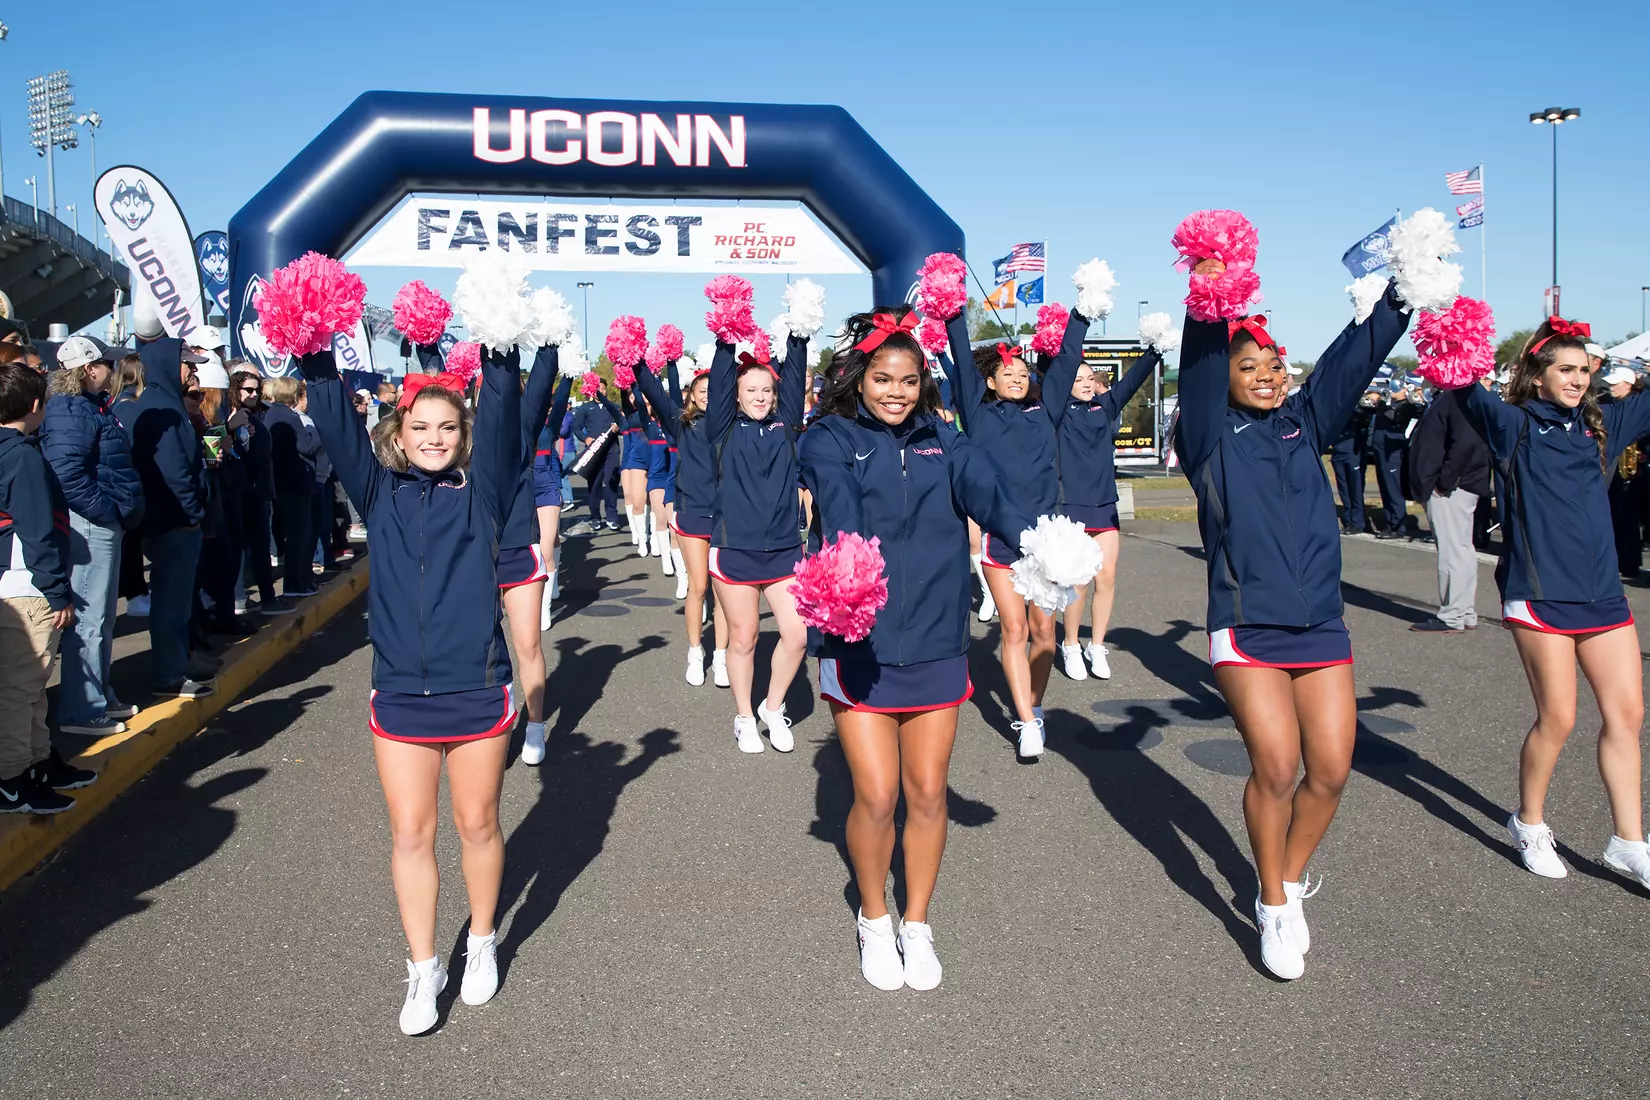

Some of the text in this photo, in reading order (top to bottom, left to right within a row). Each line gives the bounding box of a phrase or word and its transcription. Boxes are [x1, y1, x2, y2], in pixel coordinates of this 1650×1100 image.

[472, 107, 746, 168] UCONN
[417, 208, 703, 257] FANFEST
[714, 234, 796, 247] RICHARD
[729, 247, 781, 259] & SON
[127, 237, 197, 339] UCONN
[335, 331, 365, 371] CON
[912, 447, 943, 456] UCONN
[1114, 437, 1153, 446] COM/CT
